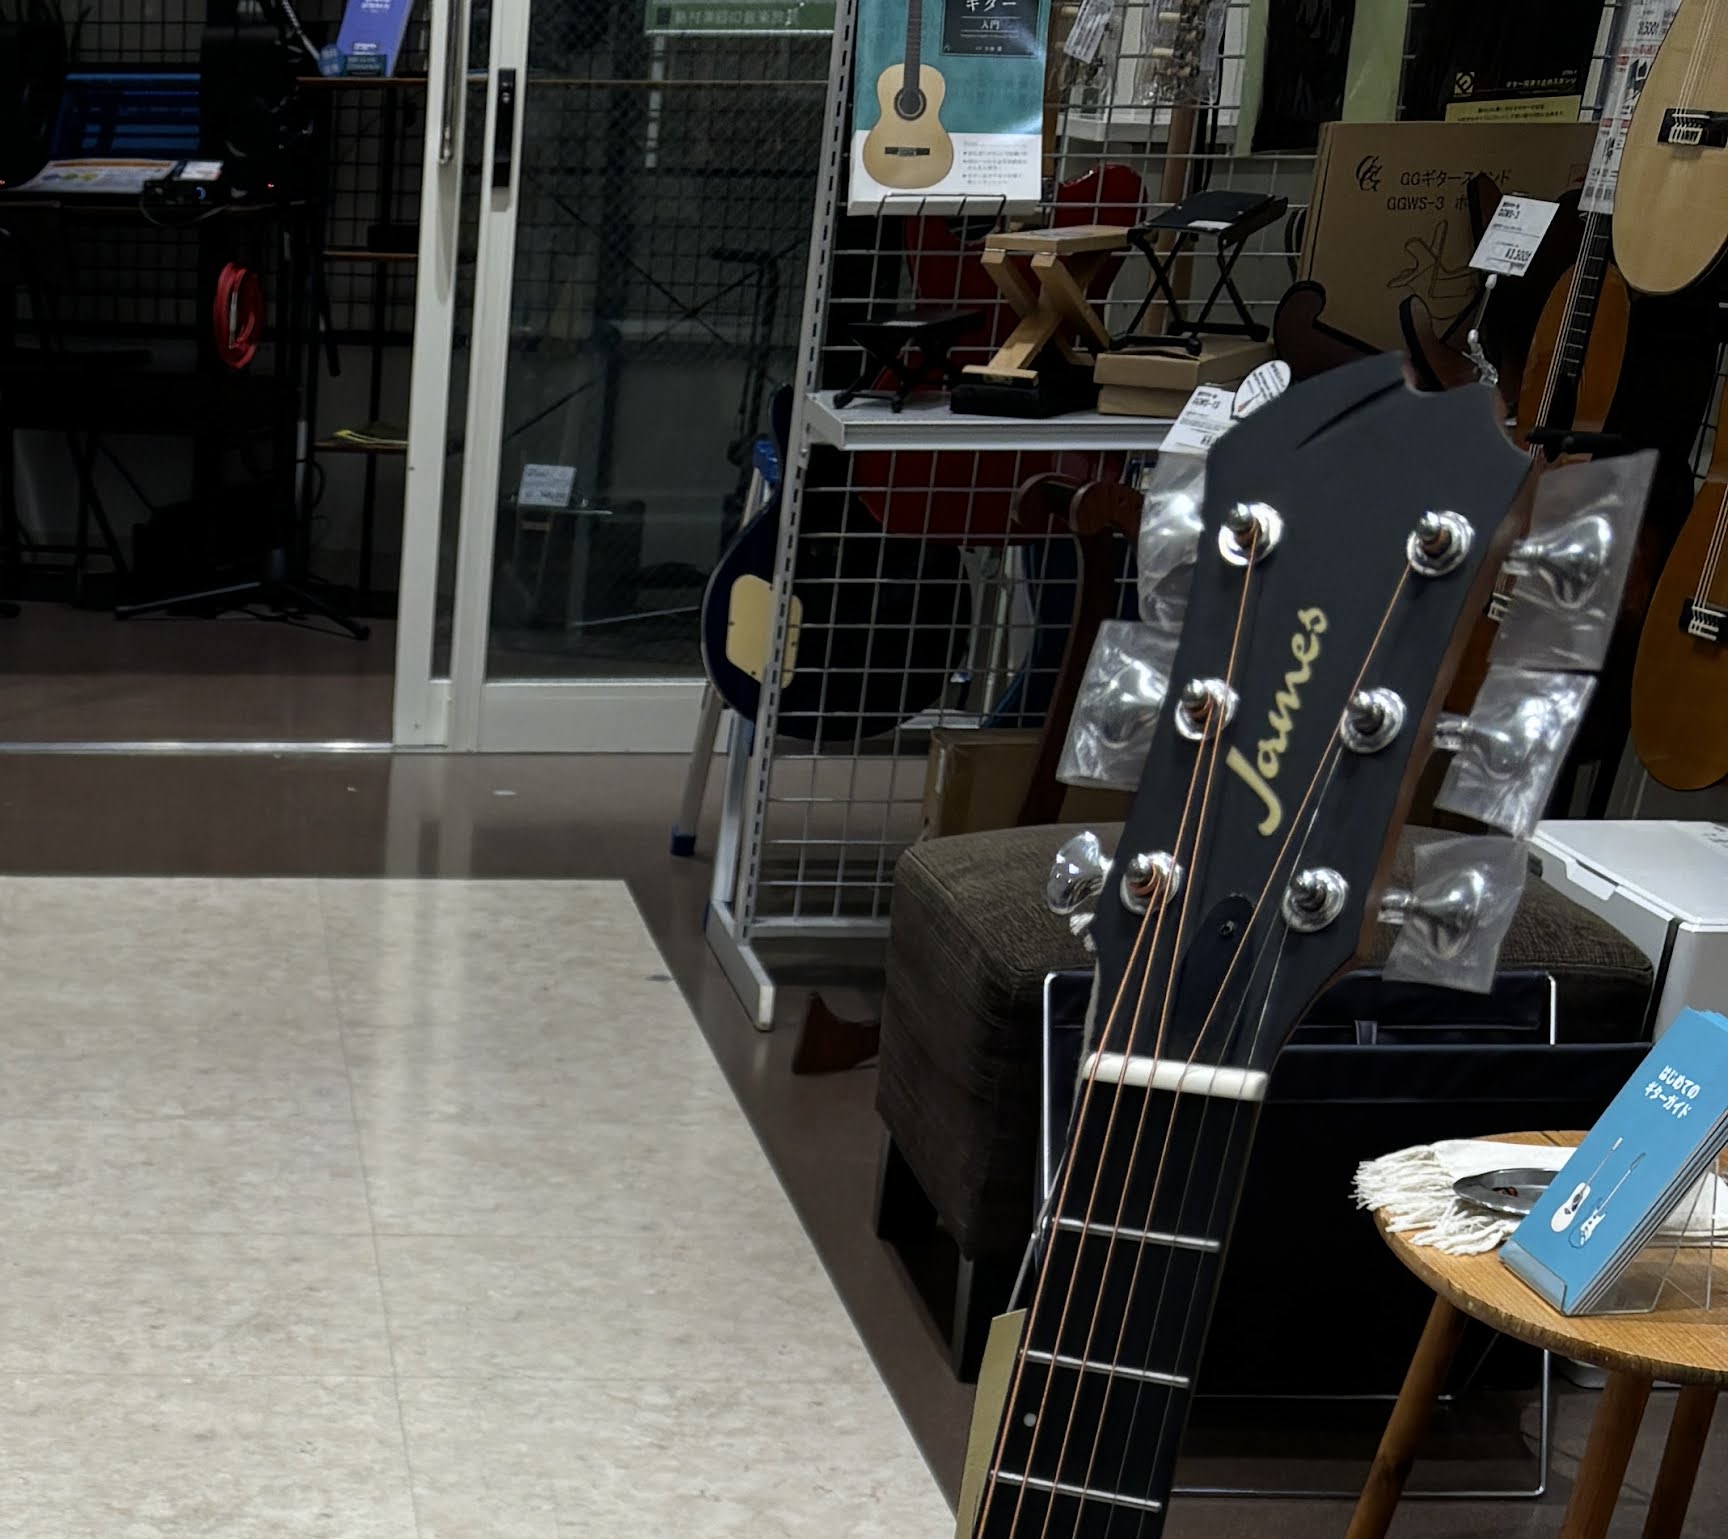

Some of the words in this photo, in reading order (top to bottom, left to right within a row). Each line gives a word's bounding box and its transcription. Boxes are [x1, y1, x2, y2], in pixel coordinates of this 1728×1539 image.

[1400, 170, 1512, 188] GGギタースンド
[1387, 196, 1445, 211] GGWS-3
[1225, 607, 1328, 837] James
[1644, 1081, 1693, 1119] ギターガイド
[1658, 1065, 1702, 1100] はじめての
